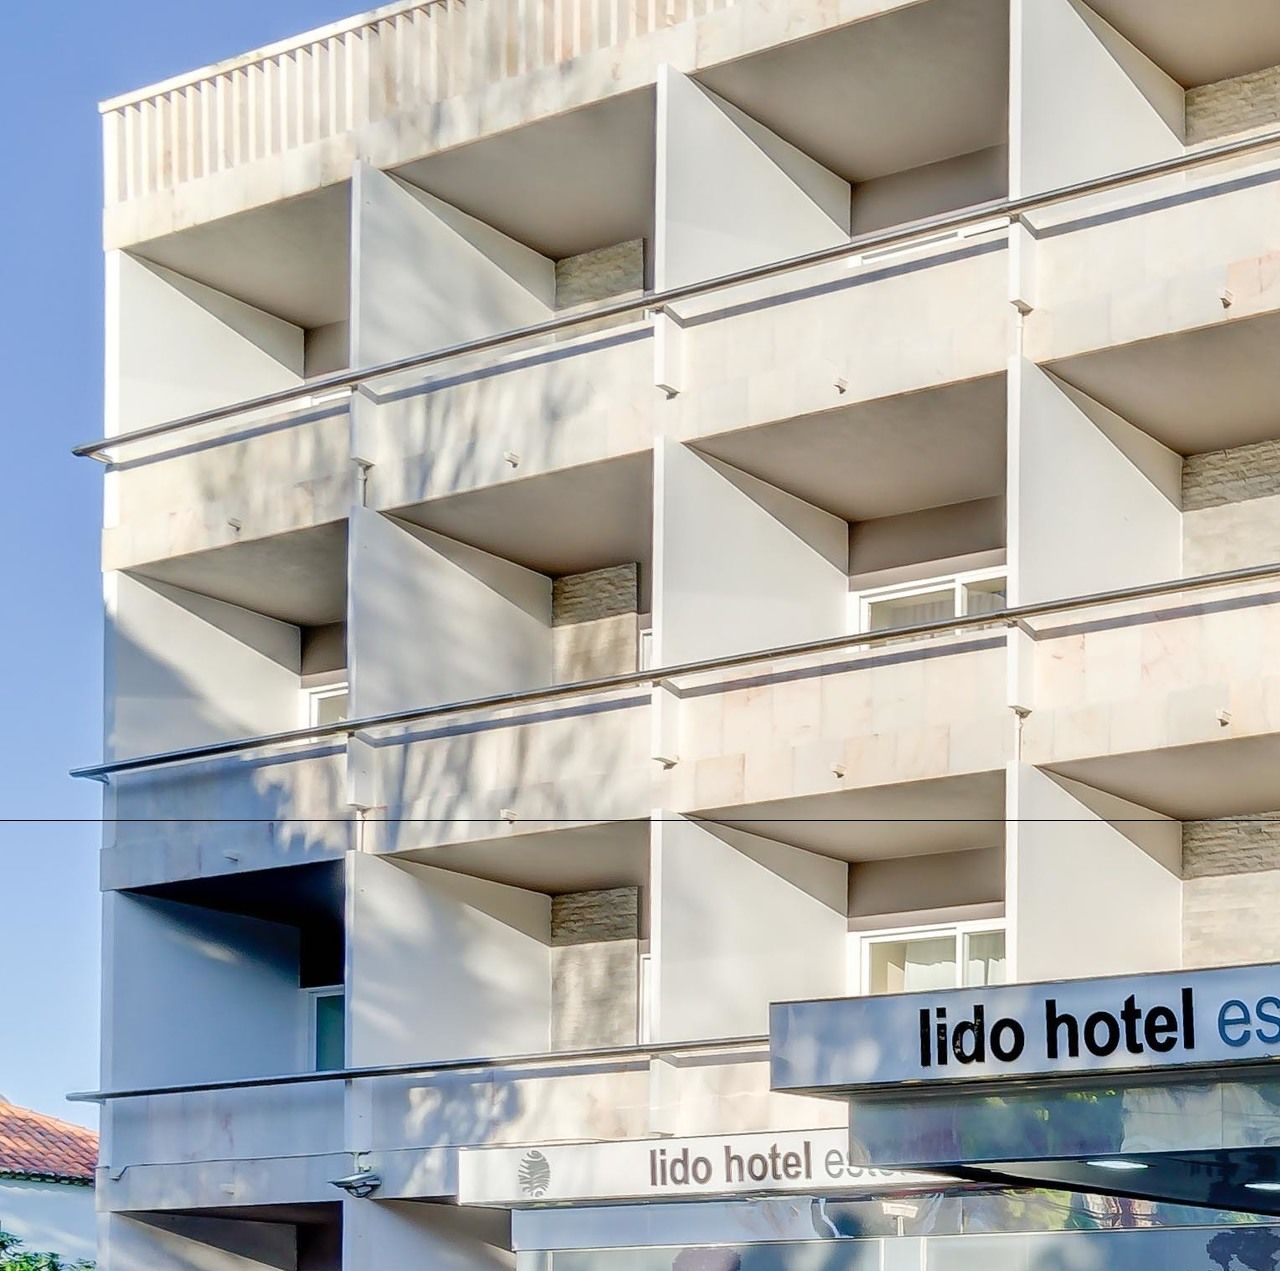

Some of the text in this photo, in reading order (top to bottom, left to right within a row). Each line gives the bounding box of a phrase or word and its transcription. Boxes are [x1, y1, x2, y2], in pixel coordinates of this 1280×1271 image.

[920, 1004, 1025, 1067] lido
[1045, 987, 1195, 1059] hotel
[648, 1147, 712, 1187] lido
[724, 1140, 813, 1184] hotel
